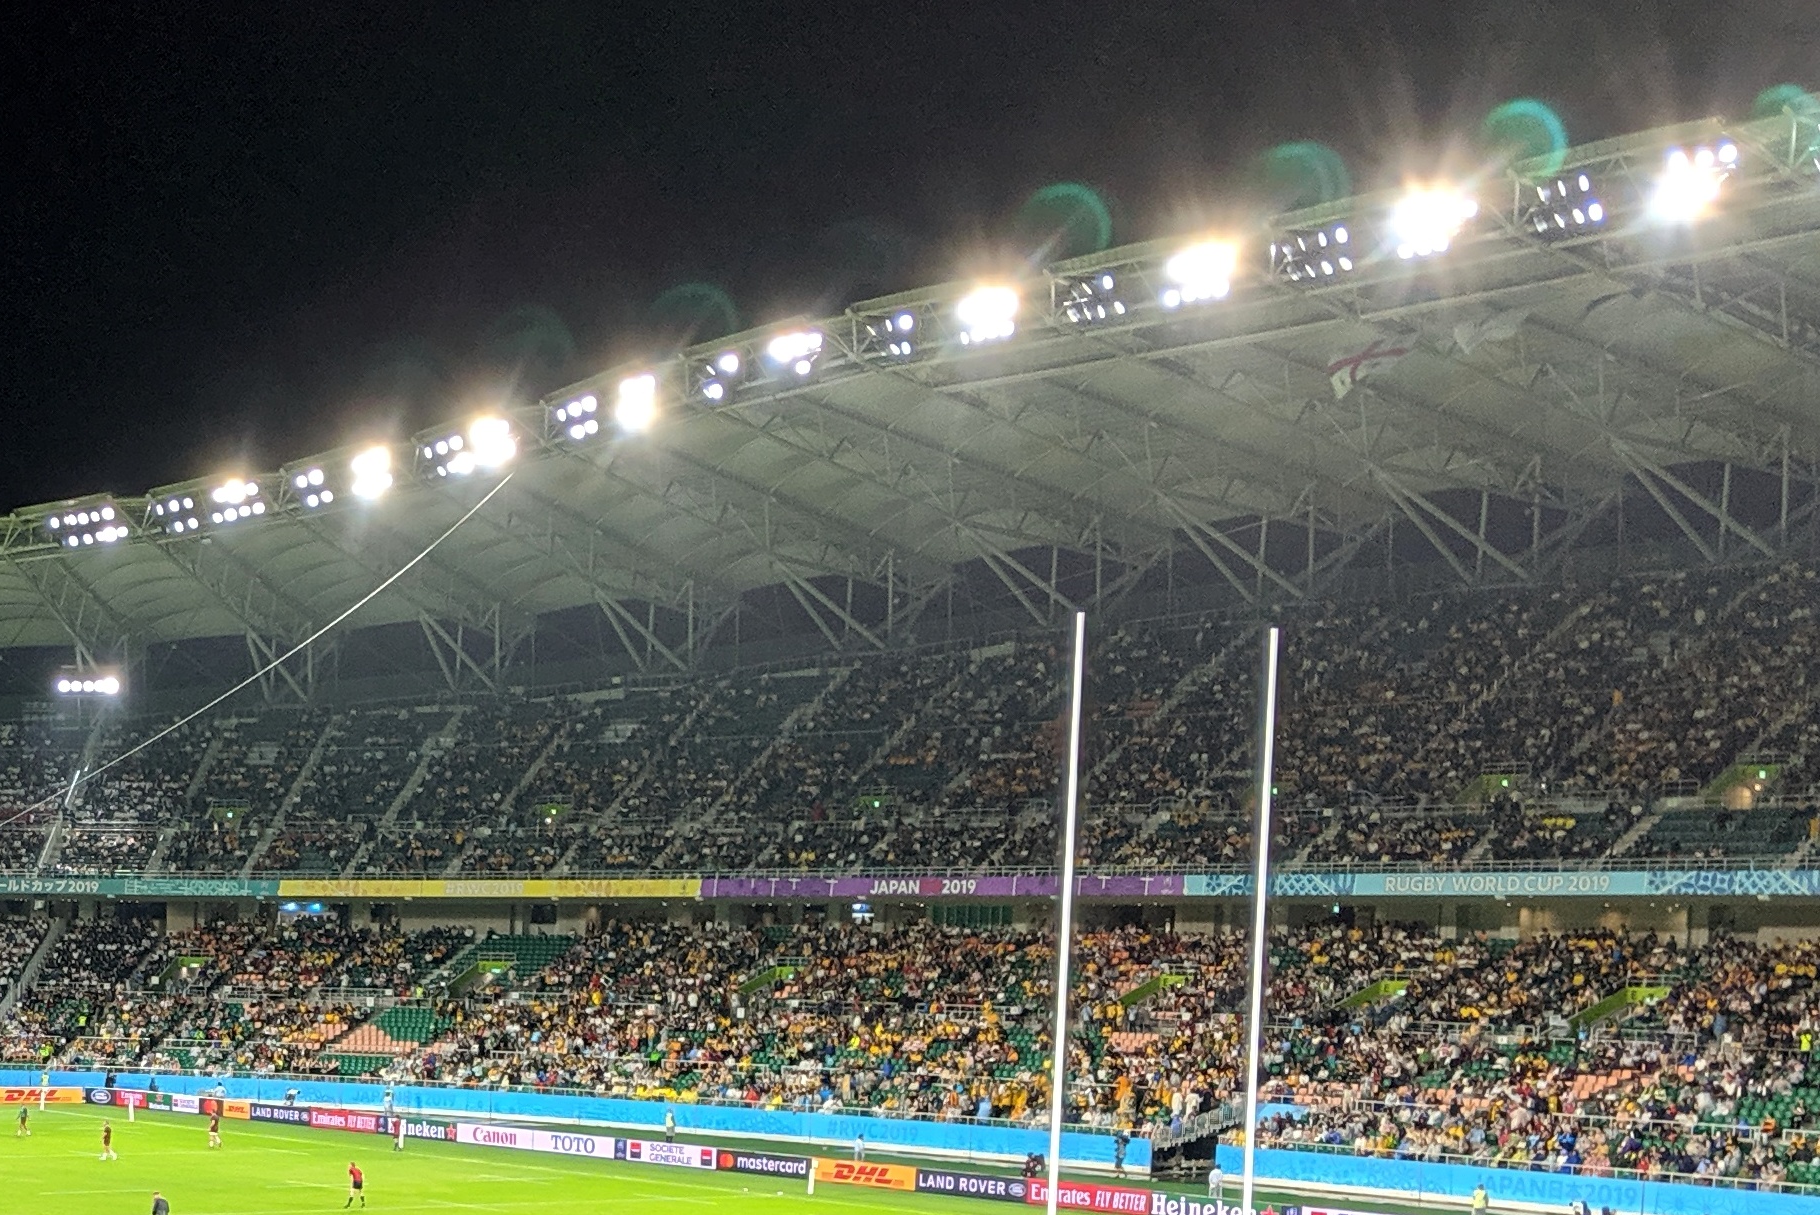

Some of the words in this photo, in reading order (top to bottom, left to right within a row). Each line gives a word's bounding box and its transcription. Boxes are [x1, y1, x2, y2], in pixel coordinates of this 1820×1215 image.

[444, 881, 524, 896] #RWC2019
[870, 879, 920, 895] JAPAN
[941, 878, 976, 894] 2019
[1384, 875, 1447, 892] RUGBY
[1452, 875, 1520, 892] WORLD
[1524, 875, 1564, 892] CUP
[1567, 875, 1610, 892] 2019
[5, 1089, 62, 1102] DHL
[251, 1106, 271, 1119] LAND
[273, 1109, 299, 1121] ROVER
[312, 1112, 346, 1127] Emirates
[472, 1122, 517, 1146] Canon
[827, 1120, 919, 1142] #RWC2019
[551, 1134, 596, 1154] TOTO
[649, 1143, 685, 1155] SOCIETE
[649, 1153, 692, 1166] GENERALE
[736, 1156, 807, 1175] mastercard
[833, 1163, 895, 1184] DHL
[919, 1173, 954, 1192] LAND
[958, 1177, 1006, 1196] ROVER
[1031, 1183, 1091, 1206] Emrates
[1095, 1190, 1111, 1207] FLY
[1112, 1191, 1147, 1212] BETTER
